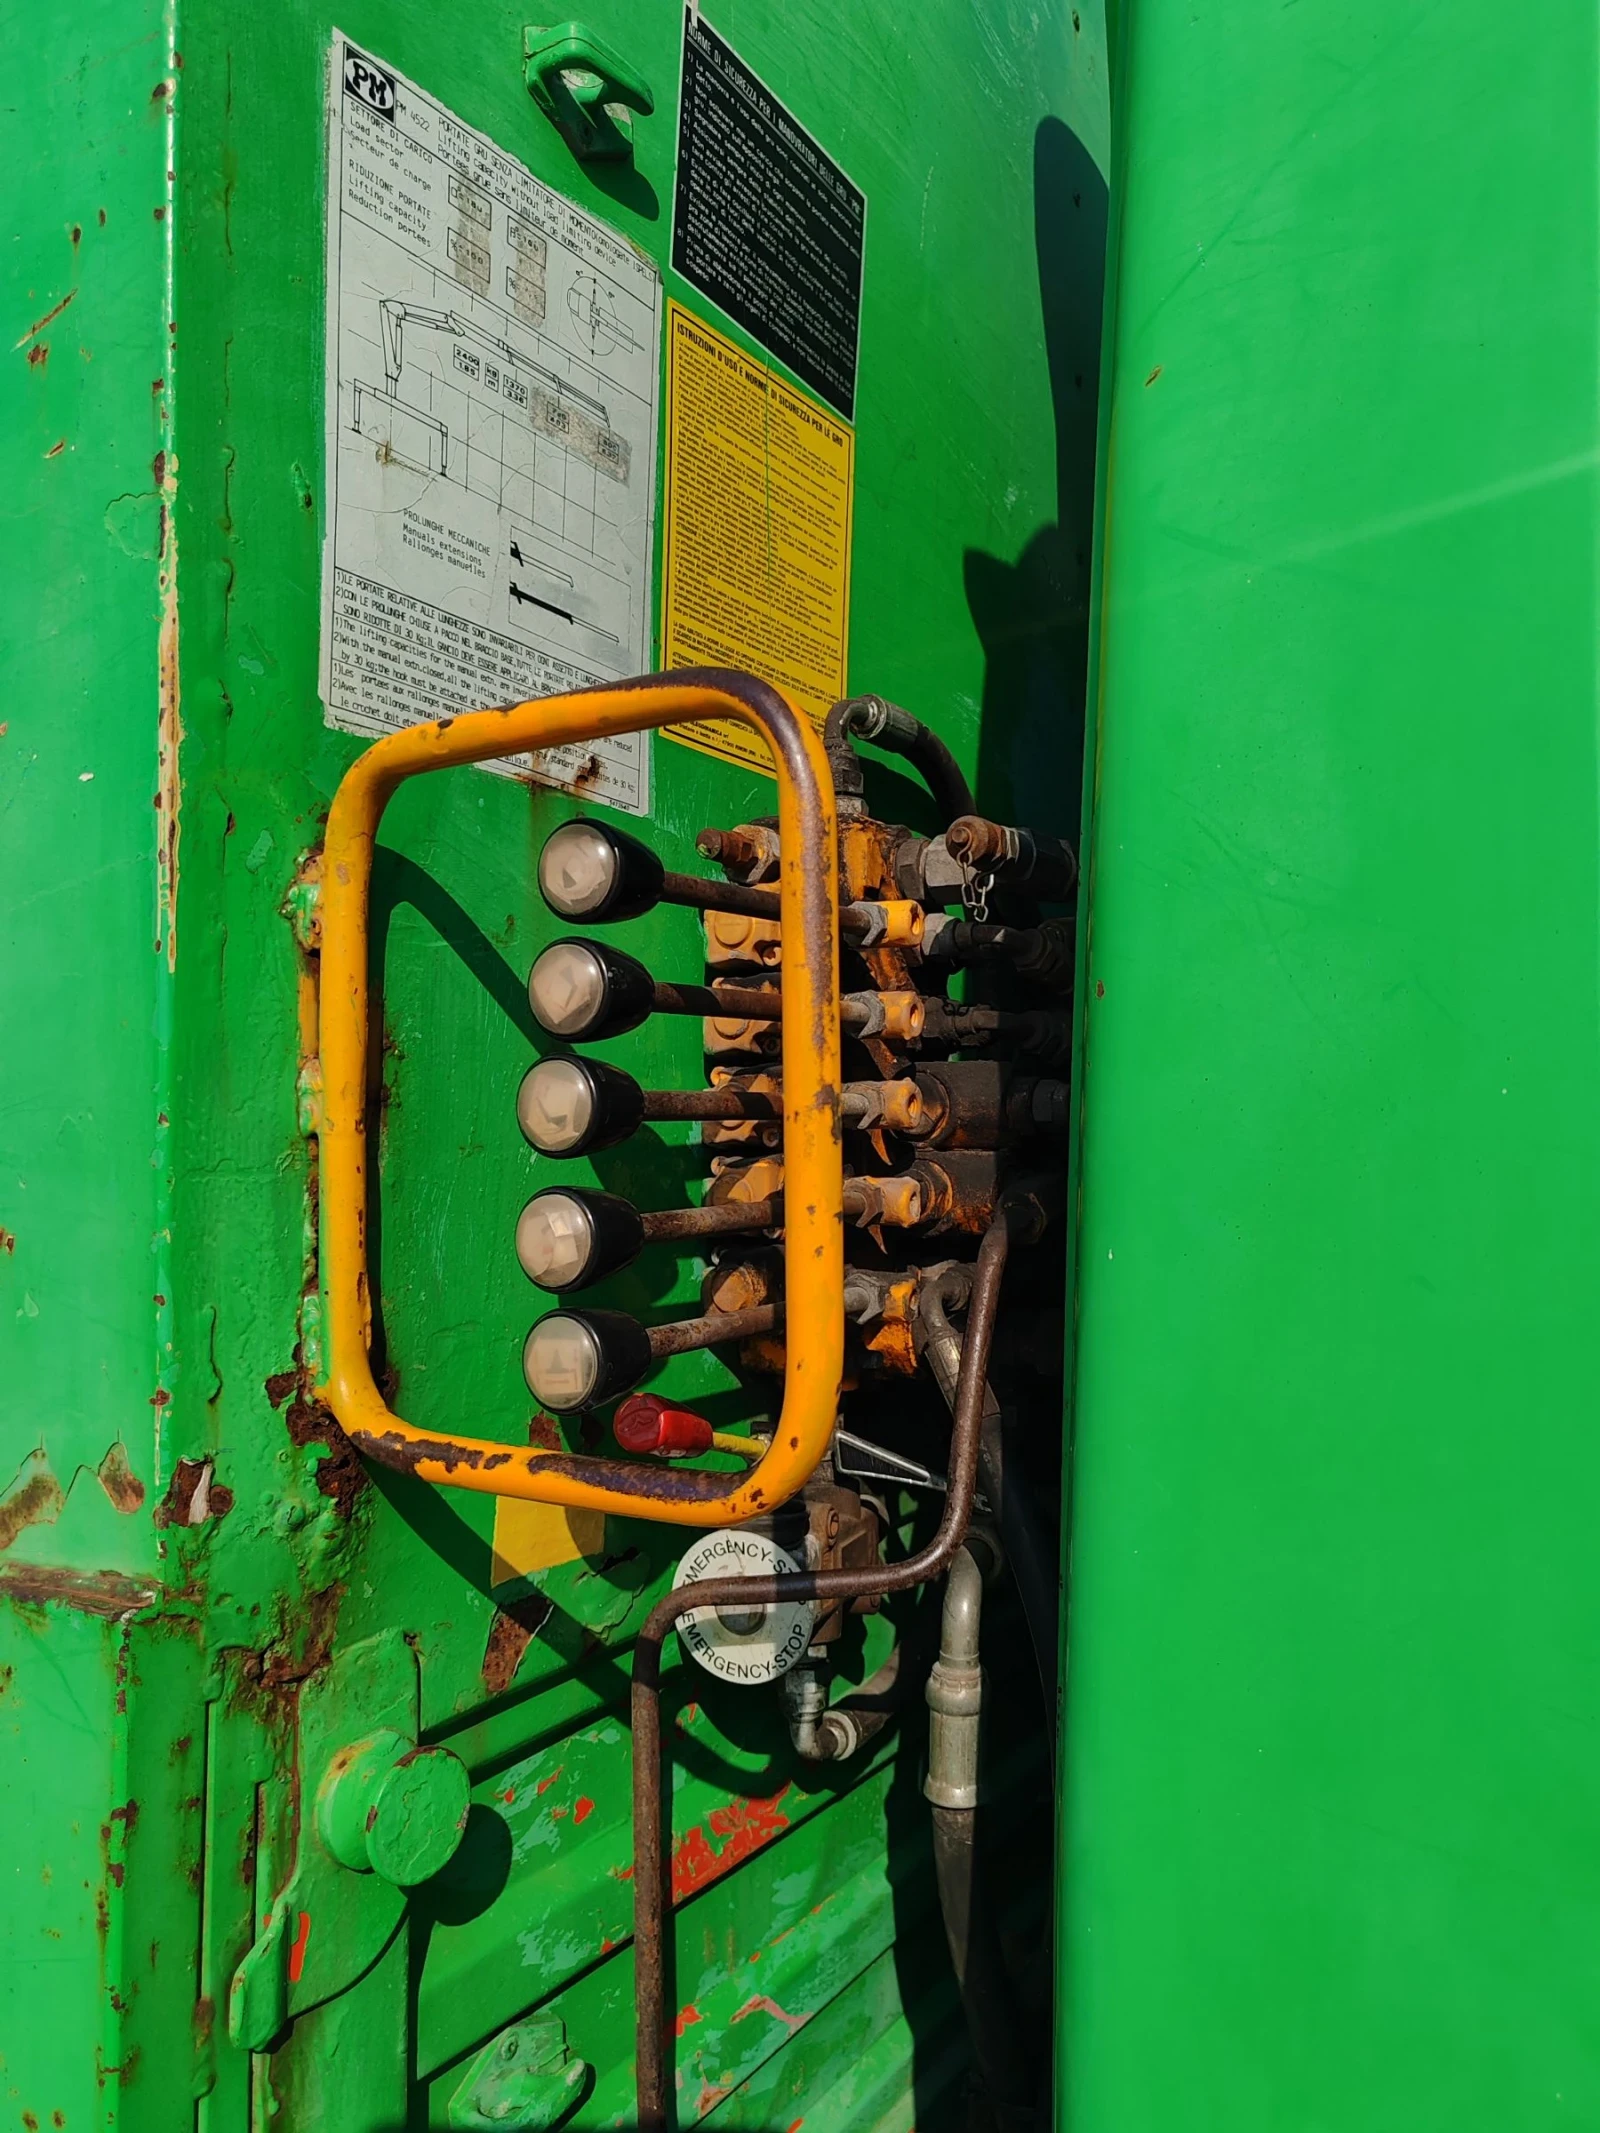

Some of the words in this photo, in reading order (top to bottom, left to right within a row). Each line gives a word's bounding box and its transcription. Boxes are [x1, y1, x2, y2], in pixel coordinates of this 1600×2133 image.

[352, 58, 386, 110] PM
[350, 99, 384, 133] SETTORE
[390, 127, 398, 142] DI
[404, 137, 432, 166] CARICO
[350, 113, 370, 137] Load
[375, 132, 403, 160] sector
[396, 98, 406, 117] PM
[410, 108, 430, 134] 4522
[714, 48, 720, 67] DI
[724, 59, 757, 105] SICUREZZA
[759, 96, 770, 119] PER
[778, 117, 817, 169] MANOVRATORI
[819, 161, 833, 187] DELLE
[349, 157, 393, 195] RIDUZIONE
[398, 190, 430, 220] PORTATE
[350, 128, 384, 161] Secteur
[389, 155, 398, 170] de
[403, 165, 431, 194] charge
[438, 114, 469, 148] PORTATE
[474, 141, 487, 161] GRU
[491, 153, 512, 179] SENZA
[515, 171, 554, 210] LIMITATORE
[558, 203, 565, 217] DI
[348, 187, 392, 225] Reduction
[398, 219, 430, 249] portees
[349, 172, 384, 206] Lifting
[388, 198, 425, 233] capacity
[437, 142, 468, 176] Portees
[473, 168, 490, 191] grue
[494, 184, 511, 205] sans
[516, 198, 545, 229] limiteur
[550, 224, 558, 239] de
[561, 232, 583, 257] moment
[438, 129, 469, 163] Lifting
[473, 156, 507, 190] capacity
[511, 182, 538, 212] without
[543, 206, 558, 226] load
[562, 220, 591, 250] limiting
[594, 243, 616, 268] device
[456, 347, 478, 367] 2400
[505, 377, 525, 396] 1370
[677, 321, 716, 359] ISTRUZIONI
[717, 349, 737, 373] D'USO
[771, 388, 778, 401] DI
[778, 394, 810, 425] SICUREZZA
[811, 417, 822, 433] PER
[402, 522, 435, 545] Manuals
[439, 539, 481, 566] extensions
[402, 533, 443, 562] Rallonges
[403, 507, 444, 535] PROLUNGHE
[448, 528, 490, 557] MECCANICHE
[343, 604, 360, 619] SONO
[363, 611, 390, 630] RIDOTTE
[394, 623, 401, 634] DI
[404, 628, 413, 639] 30
[437, 640, 459, 657] GANCIO
[461, 650, 475, 664] DEVE
[477, 656, 497, 673] ESSERE
[500, 666, 529, 685] APPLICATO
[532, 678, 539, 689] AL
[356, 579, 384, 599] PORTATE
[387, 591, 417, 612] RELATIVE
[420, 604, 434, 619] ALLE
[438, 612, 468, 633] LUNGHEZZE
[471, 625, 486, 640] SONO
[489, 633, 522, 655] INVARIABILI
[525, 648, 535, 661] PER
[360, 595, 368, 607] LE
[371, 599, 405, 622] PROLUNGHE
[410, 615, 431, 632] CHIUSE
[441, 628, 459, 643] PACCO
[461, 636, 472, 648] NEL
[474, 641, 498, 659] BRACCIO
[534, 666, 541, 676] LE
[341, 649, 350, 663] by
[354, 654, 362, 666] 30
[392, 667, 407, 682] hook
[410, 674, 426, 688] must
[429, 681, 436, 692] be
[439, 685, 467, 703] attached
[470, 697, 477, 707] at
[359, 625, 386, 646] lifting
[389, 638, 427, 660] capacities
[430, 652, 441, 665] for
[444, 658, 455, 670] the
[457, 663, 477, 679] manual
[499, 681, 510, 691] are
[362, 641, 375, 655] the
[378, 647, 400, 664] manual
[460, 678, 471, 690] the
[474, 683, 497, 701] lifting
[341, 696, 348, 708] le
[352, 700, 380, 718] crochet
[383, 710, 399, 724] doit
[361, 674, 389, 691] portees
[393, 684, 403, 695] aux
[408, 689, 439, 709] rallonges
[361, 687, 373, 700] les
[377, 692, 410, 714] rallonges
[682, 1540, 806, 1605] MERGENCY-S
[682, 1612, 807, 1680] EMERGENCY-STOP
